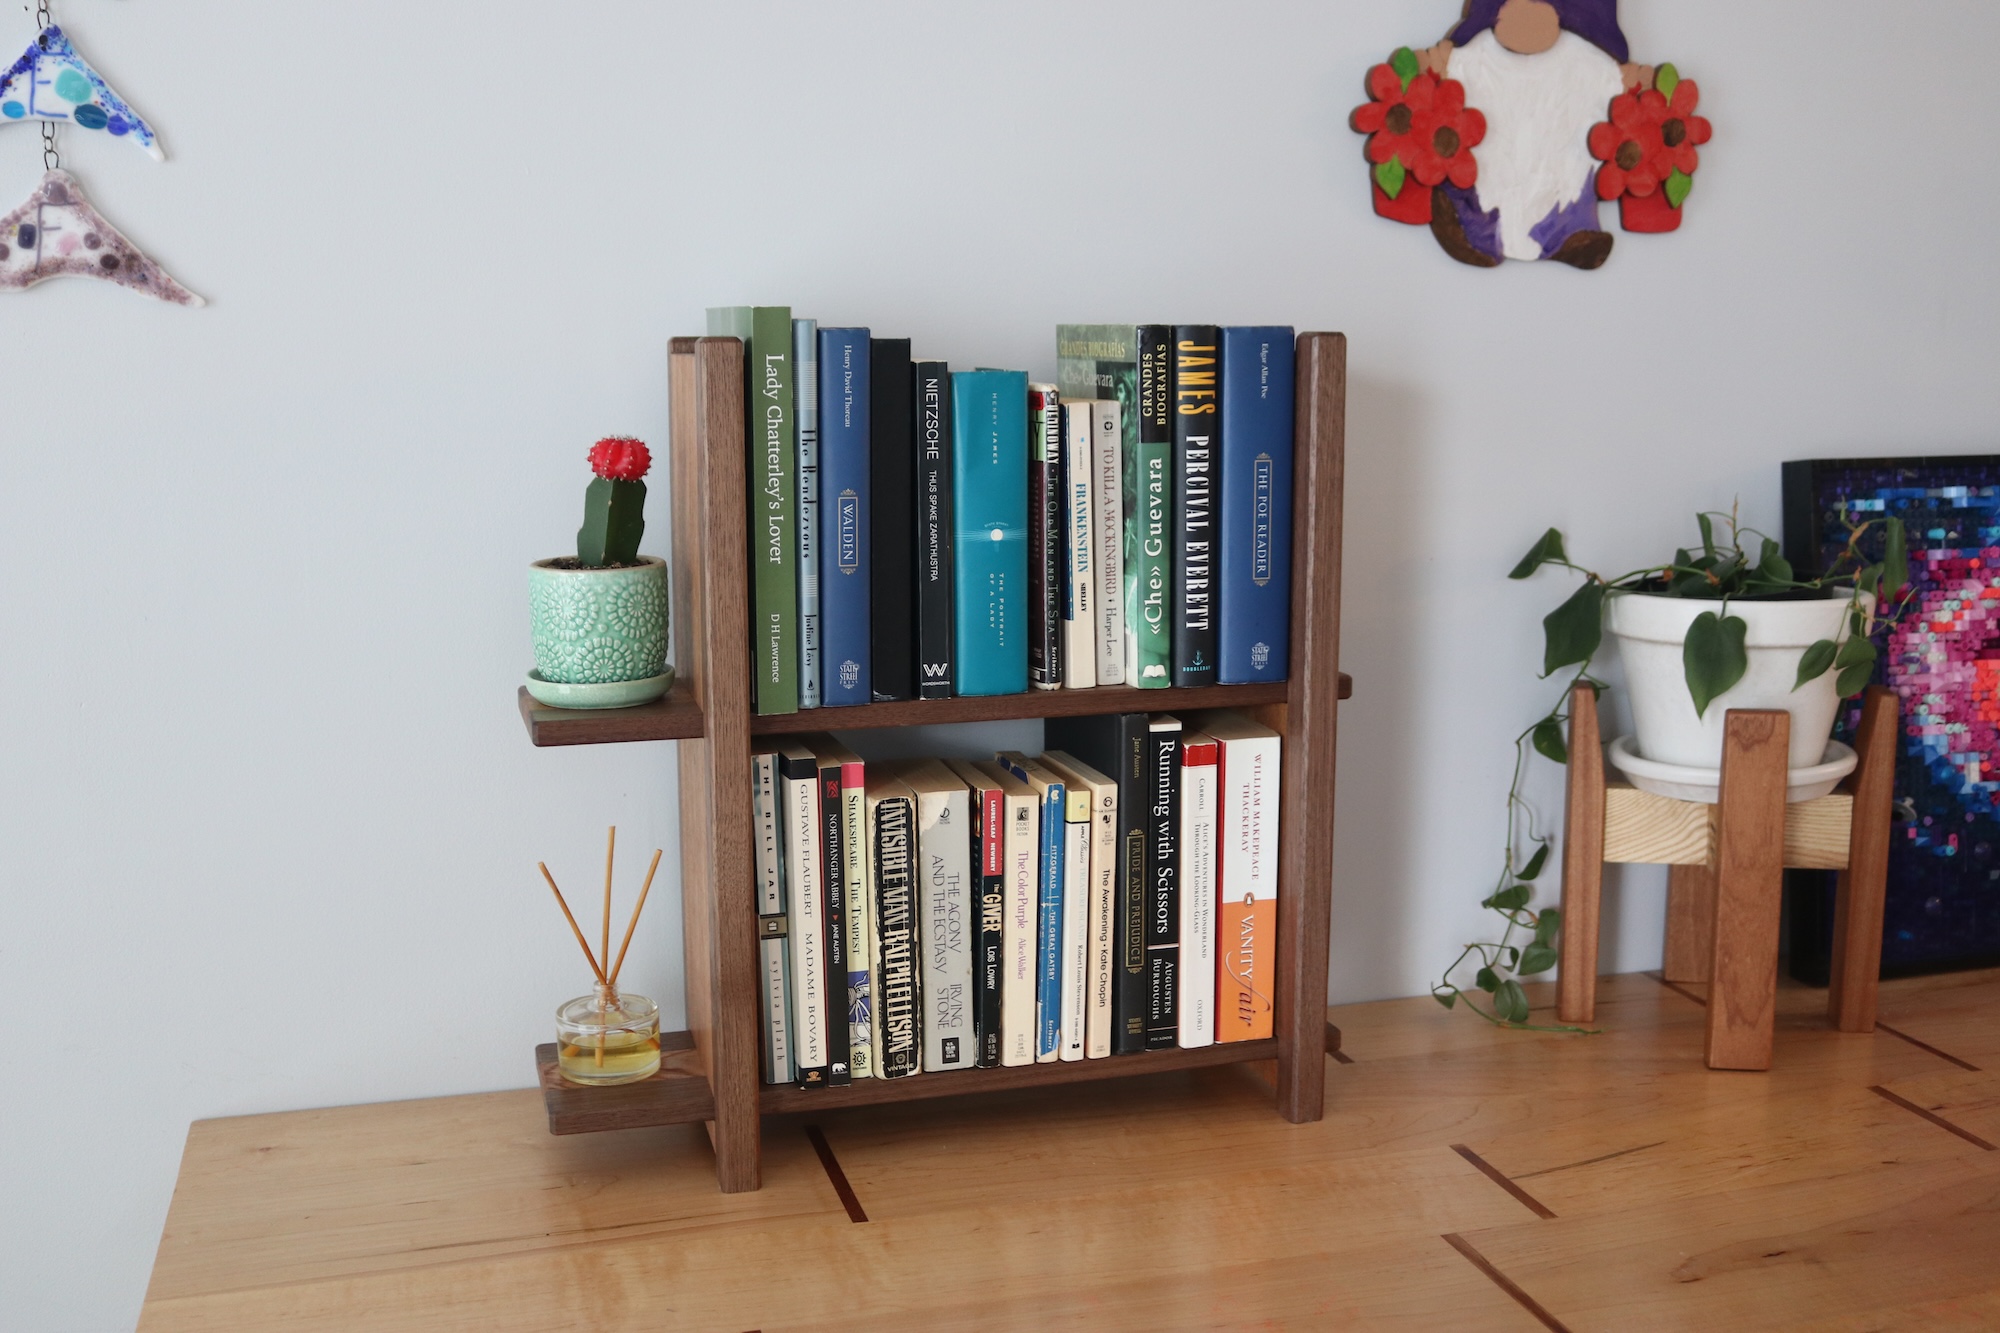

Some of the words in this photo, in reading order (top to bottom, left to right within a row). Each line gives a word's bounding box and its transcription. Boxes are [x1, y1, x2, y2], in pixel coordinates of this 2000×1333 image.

[843, 345, 853, 369] Henry
[1259, 343, 1269, 363] Edgar
[763, 354, 785, 400] Lady
[844, 371, 853, 394] David
[1142, 353, 1152, 417] GRANDES
[1153, 344, 1167, 426] BIOGRAFÍAS
[1177, 340, 1216, 415] JAMES
[1261, 365, 1269, 384] Allan
[844, 396, 853, 427] Thoreau
[925, 378, 939, 460] NIETZSCHE
[801, 427, 816, 456] The
[1046, 404, 1059, 464] HEMINGWAY
[764, 405, 785, 510] Chatterley's
[1104, 446, 1114, 464] TO
[928, 470, 937, 493] THUS
[1104, 464, 1114, 493] KILL
[1185, 435, 1210, 532] PERCIVAL
[1258, 466, 1268, 490] THE
[801, 465, 816, 558] Rendezvous
[929, 494, 938, 521] SPAKE
[1047, 501, 1058, 525] OLD
[1104, 493, 1115, 506] A
[1144, 458, 1163, 557] Guevara
[1257, 496, 1267, 518] POE
[768, 515, 784, 564] Lover
[842, 504, 853, 560] WALDEN
[1047, 529, 1058, 554] MAN
[1075, 483, 1088, 573] FRANKENSTEIN
[929, 523, 938, 581] ZARATHUSTRA
[1104, 509, 1116, 595] MOCKINGBIRD
[1257, 524, 1267, 573] READER
[990, 573, 995, 584] OF
[1185, 541, 1209, 631] EVERETT
[771, 613, 780, 621] D
[1143, 566, 1163, 635] «Che»
[771, 624, 780, 634] H
[803, 614, 817, 645] Justine
[1047, 610, 1058, 633] SEA
[1104, 607, 1117, 637] Harper
[771, 636, 781, 683] Lawrence
[804, 647, 817, 667] Lévy
[1050, 646, 1058, 677] Scribners
[1106, 640, 1117, 656] Lee
[1132, 737, 1141, 753] Jane
[1133, 754, 1141, 778] Austen
[1153, 739, 1175, 816] Running
[1253, 753, 1261, 806] WILLIAM
[800, 784, 810, 846] GUSTAVE
[848, 795, 859, 869] SHAKESPEARE
[1241, 783, 1250, 853] THACKERAY
[828, 814, 839, 881] NORTHANGER
[880, 801, 909, 885] INVISIBLE
[1017, 851, 1029, 869] The
[1079, 838, 1089, 864] Classics
[1131, 841, 1140, 872] PRIDE
[1157, 821, 1172, 860] with
[1252, 811, 1260, 880] MAKEPEACE
[802, 850, 812, 918] FLAUBERT
[931, 855, 944, 886] AND
[947, 871, 960, 897] THE
[1017, 870, 1029, 897] Color
[1078, 867, 1086, 909] TREASURE
[1102, 869, 1110, 886] The
[1131, 877, 1140, 901] AND
[830, 881, 840, 909] ABBEY
[850, 878, 861, 903] THE
[883, 886, 909, 926] MAN
[933, 891, 945, 916] THE
[1157, 867, 1173, 934] Scissors
[1202, 899, 1208, 907] IN
[831, 924, 839, 939] JANE
[851, 905, 862, 955] TEMPEST
[948, 901, 961, 953] AGONY
[982, 893, 1002, 933] GIVER
[1015, 898, 1029, 929] Purple
[1078, 910, 1086, 941] ISLAND
[1099, 888, 1109, 942] Awakening
[832, 940, 840, 964] AUSTEN
[932, 918, 946, 974] ECSTASY
[1018, 937, 1027, 956] Alice
[1131, 905, 1141, 961] PREJUDICE
[1239, 914, 1254, 981] VANITY
[805, 933, 815, 999] MADAME
[884, 929, 912, 986] RALPH
[987, 946, 997, 963] LOIS
[1018, 956, 1027, 981] Walker
[1100, 949, 1108, 971] Kate
[770, 960, 782, 1008] sylvia
[986, 964, 997, 990] LOWRY
[1099, 972, 1108, 1007] Chopin
[1152, 958, 1162, 1020] BURROUGHS
[1164, 961, 1174, 1014] AUGUSTEN
[1225, 951, 1271, 1027] fair
[886, 988, 914, 1054] ELLISON
[936, 988, 950, 1030] STONE
[950, 984, 962, 1028] IRVING
[772, 1020, 785, 1061] plath
[808, 1005, 818, 1062] BOVARY
[887, 1062, 914, 1072] VINTAGE
